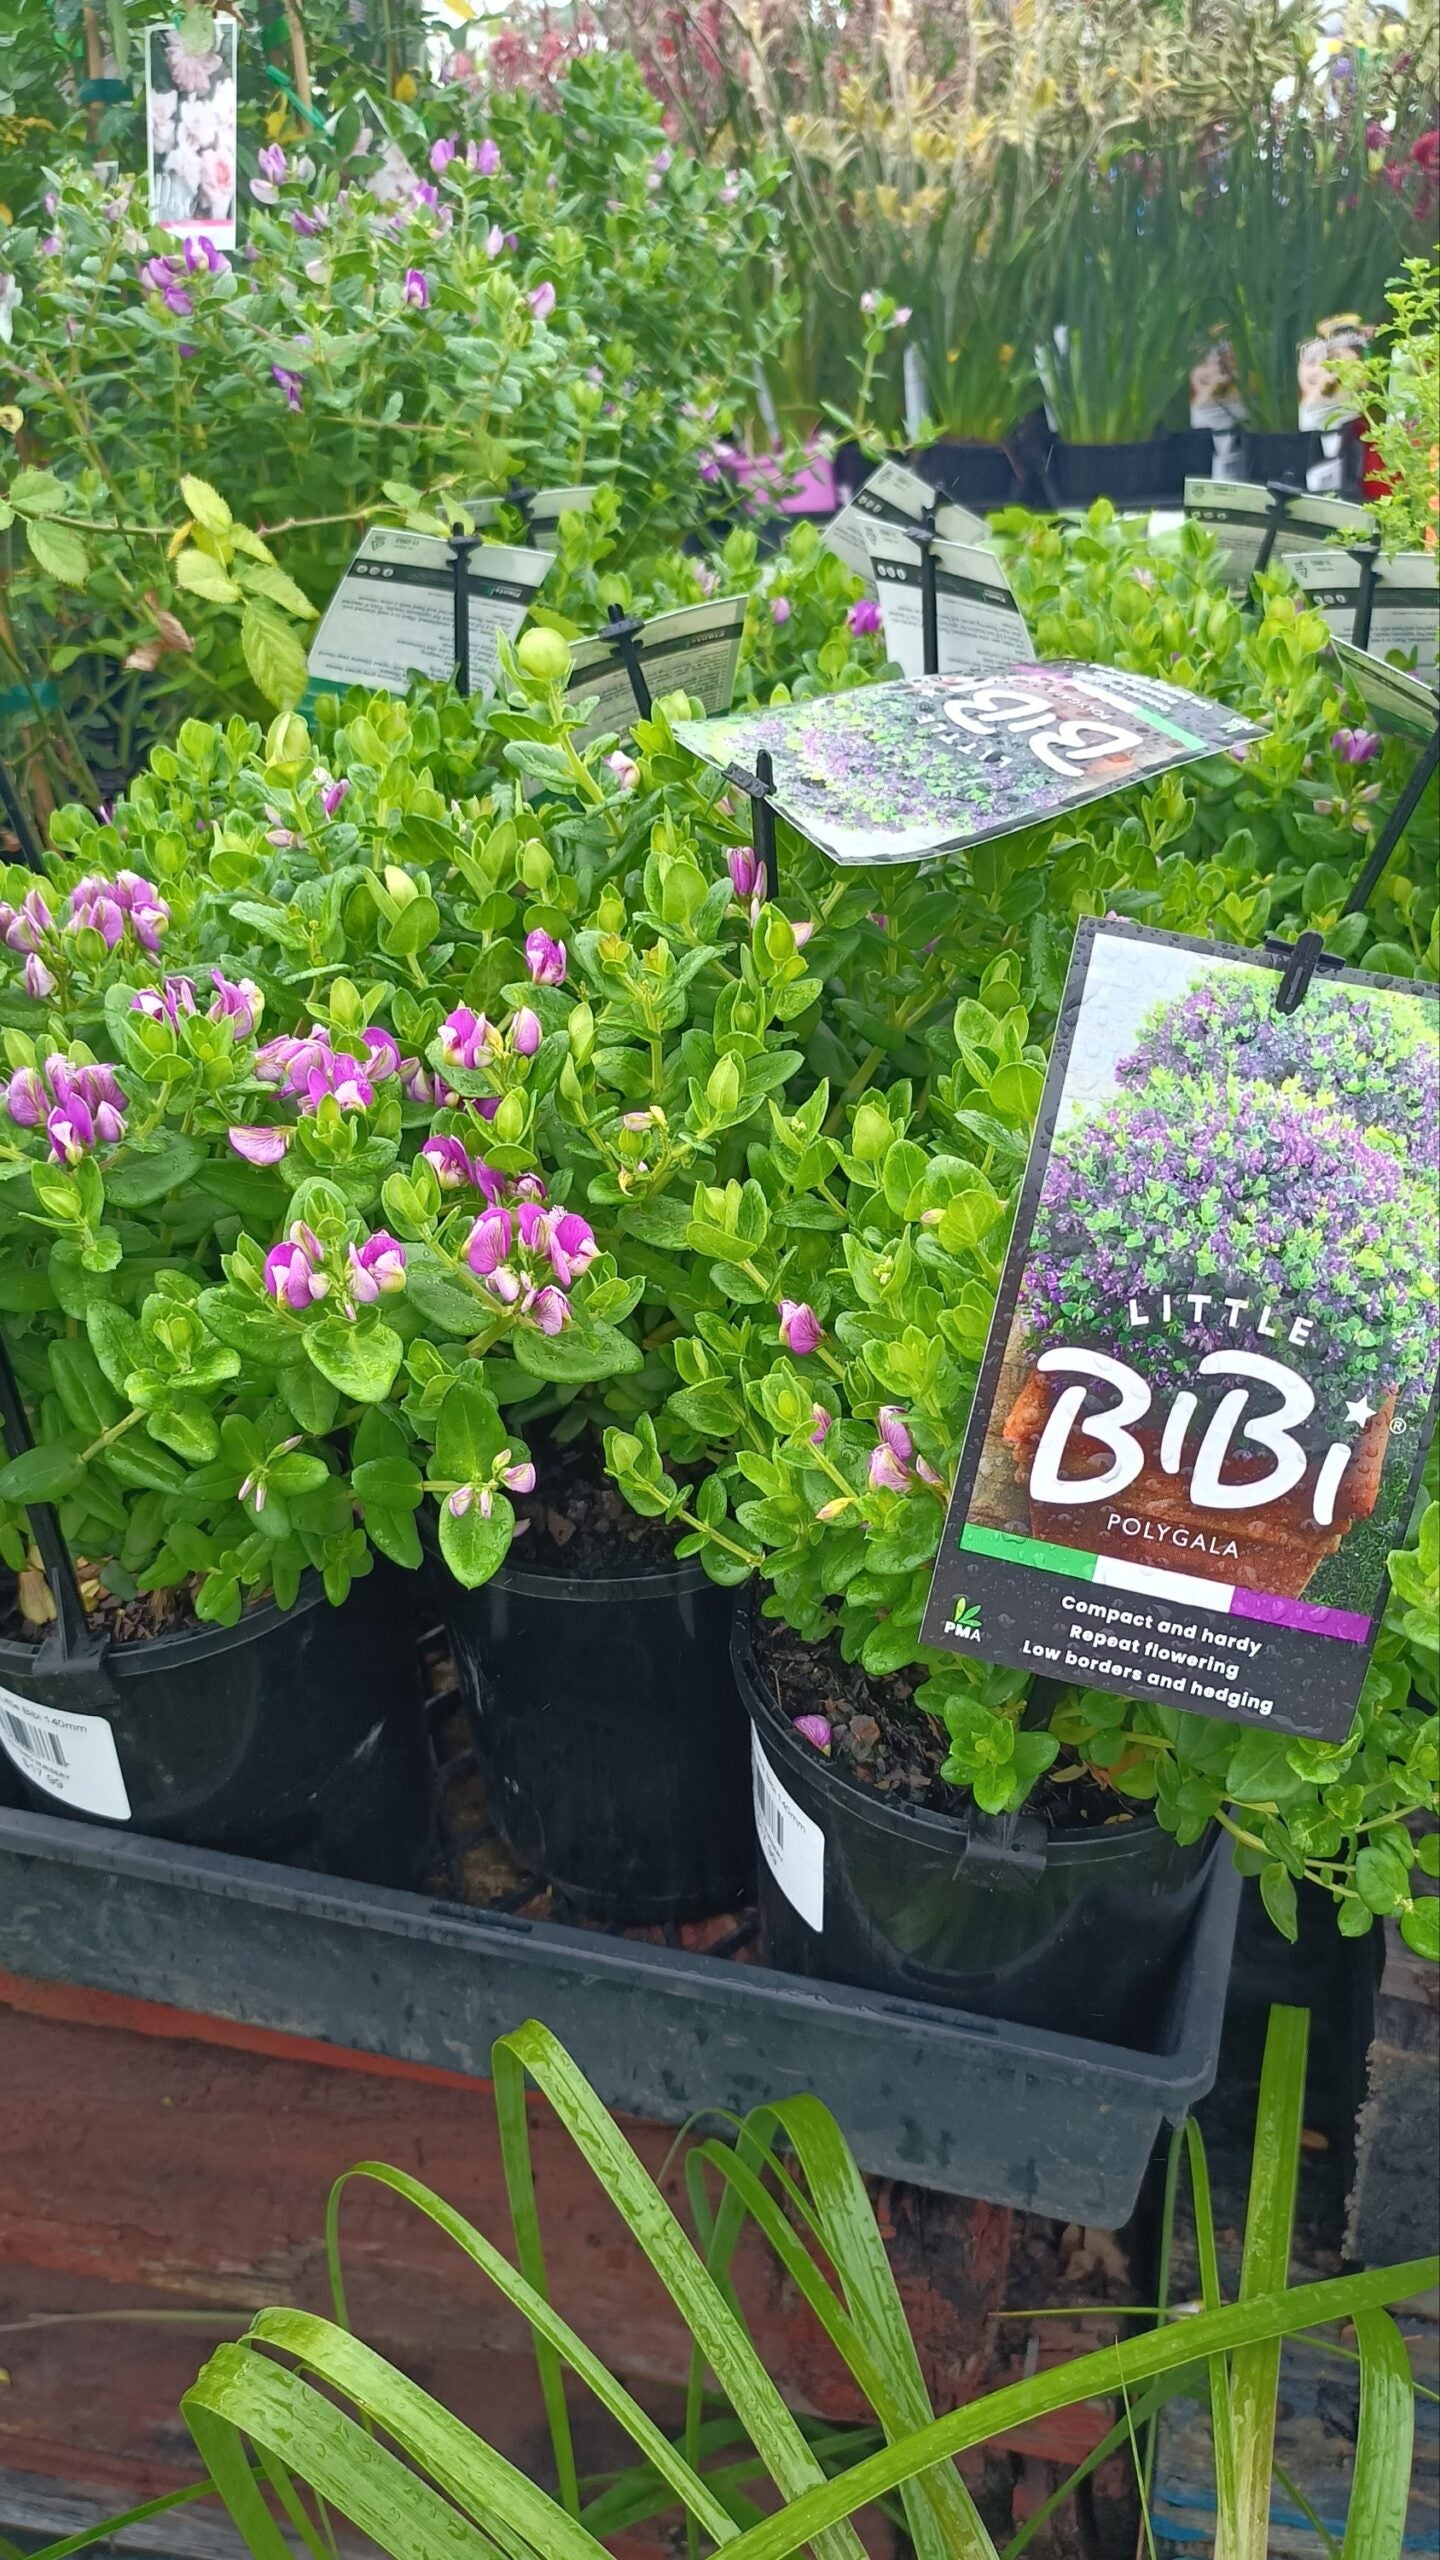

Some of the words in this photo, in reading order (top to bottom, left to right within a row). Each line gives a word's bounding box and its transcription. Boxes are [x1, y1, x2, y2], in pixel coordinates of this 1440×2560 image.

[916, 714, 1011, 768] LITTLE
[1129, 1295, 1313, 1346] LITTLE
[1107, 1514, 1239, 1558] POLYGALA
[944, 1622, 981, 1642] PMA
[1061, 1595, 1154, 1630] Compact
[1157, 1616, 1198, 1638] and
[1203, 1626, 1262, 1656] hardy
[1070, 1624, 1141, 1653] Repeat
[1144, 1641, 1240, 1680] flowering
[1022, 1640, 1061, 1661] Low
[1065, 1650, 1142, 1681] borders
[1147, 1673, 1186, 1692] and
[1191, 1680, 1274, 1715] hedging
